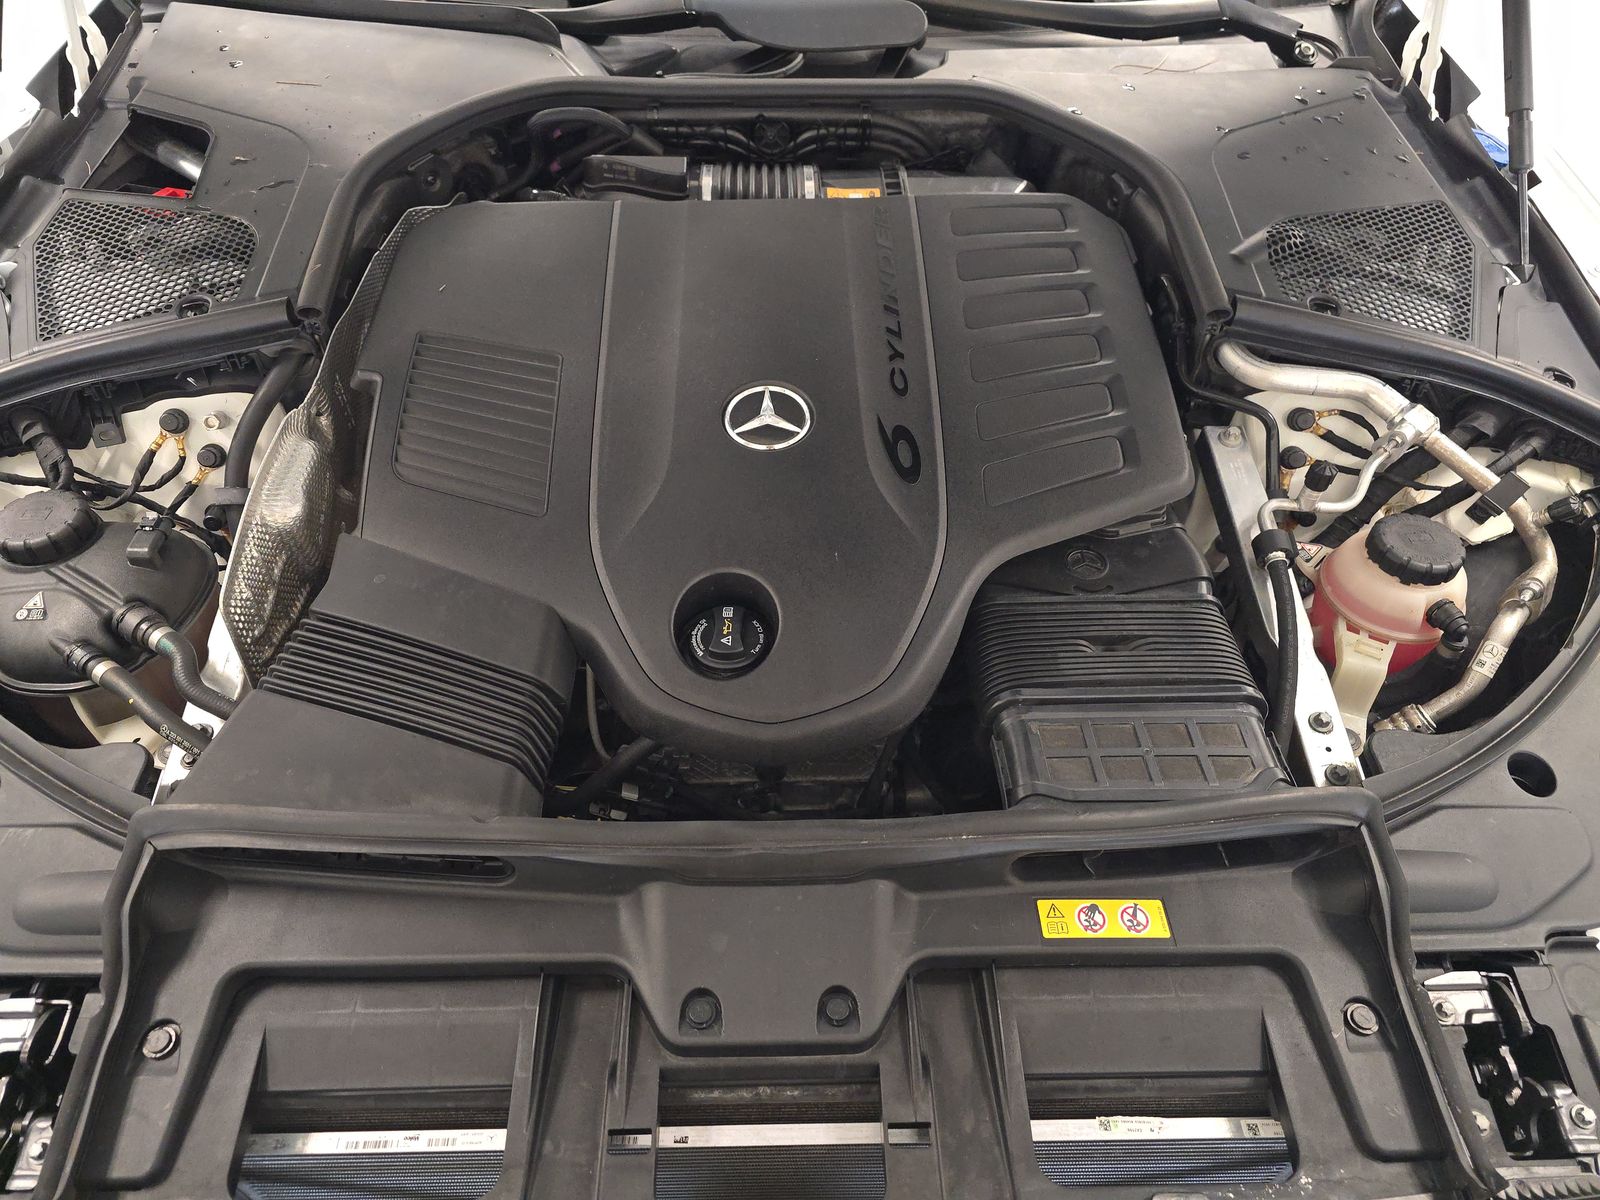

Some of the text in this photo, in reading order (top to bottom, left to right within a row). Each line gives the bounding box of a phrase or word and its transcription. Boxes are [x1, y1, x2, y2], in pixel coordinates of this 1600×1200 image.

[872, 205, 922, 486] 6 CYLINDER
[750, 644, 761, 654] Turn
